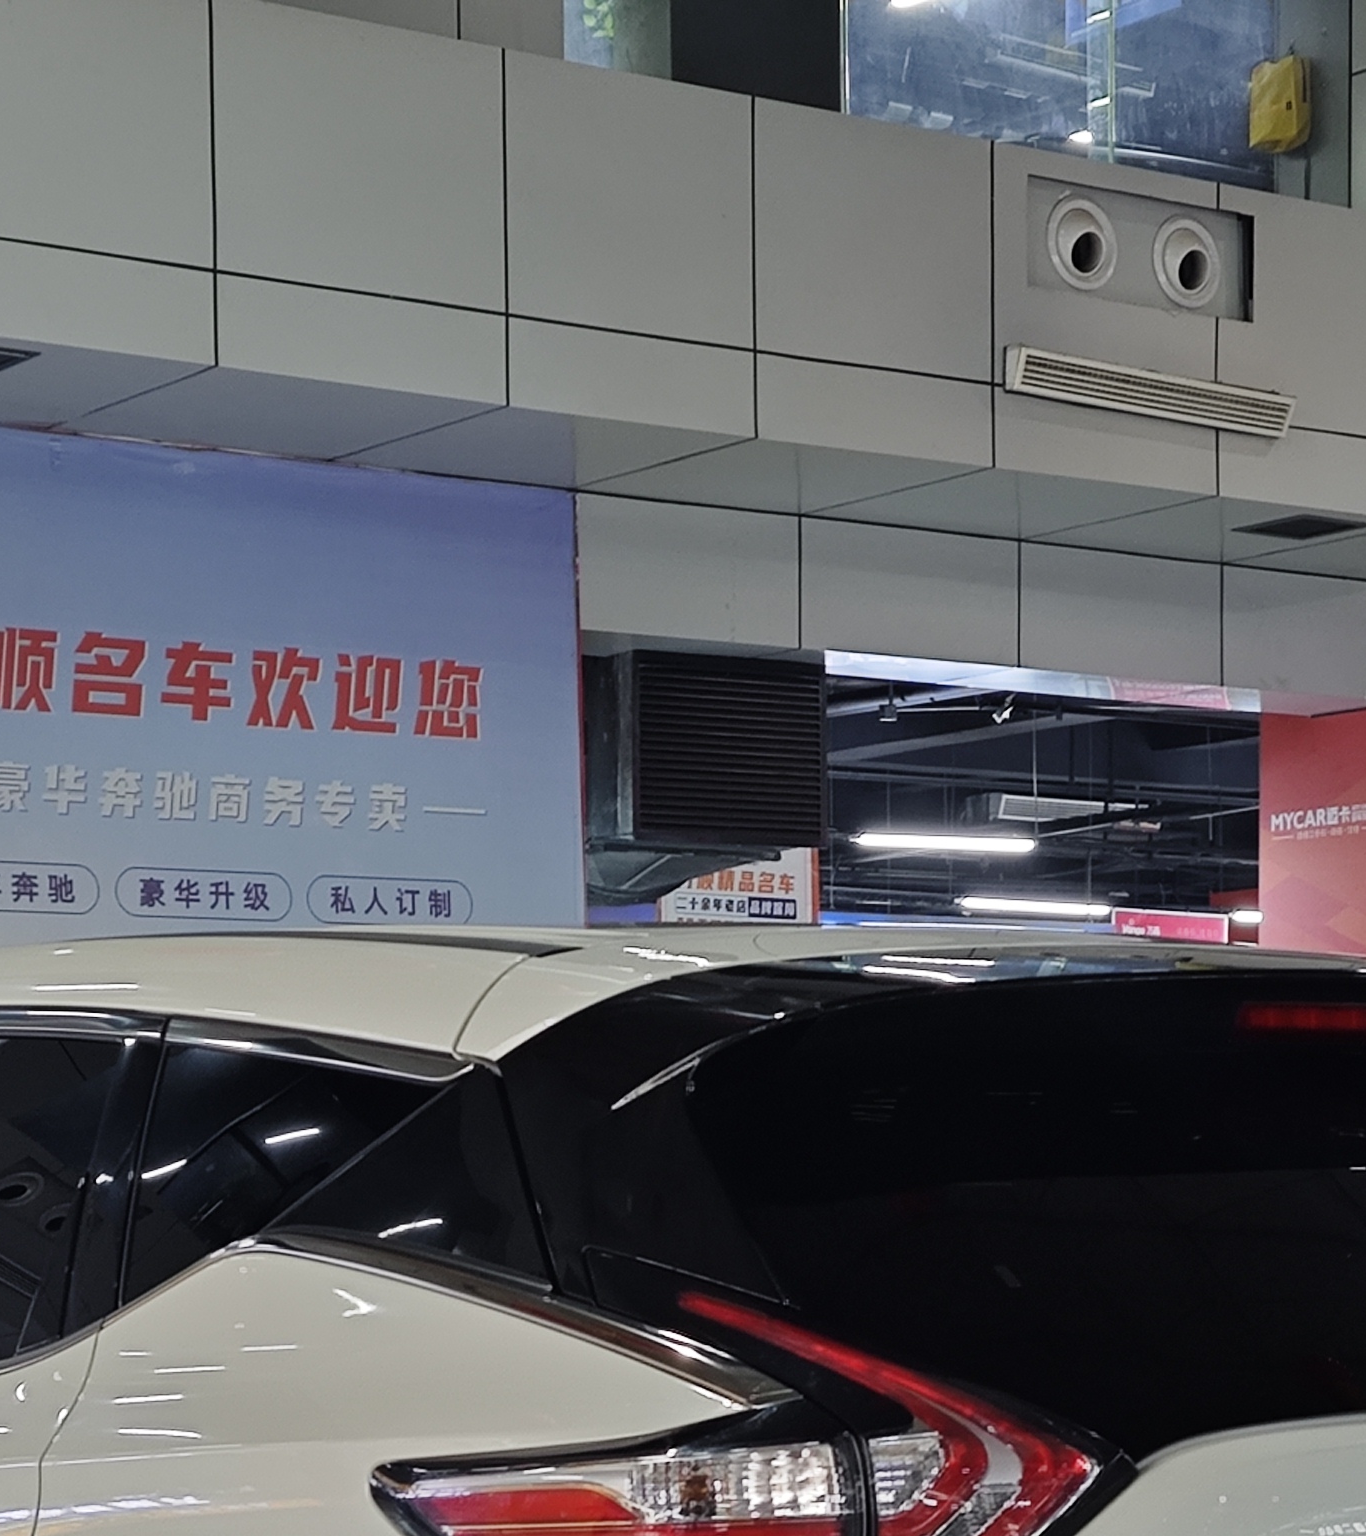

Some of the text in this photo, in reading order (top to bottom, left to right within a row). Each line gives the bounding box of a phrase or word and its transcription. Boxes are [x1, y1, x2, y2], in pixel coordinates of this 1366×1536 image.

[137, 875, 272, 913] 豪华升级
[328, 882, 455, 921] 私人订制
